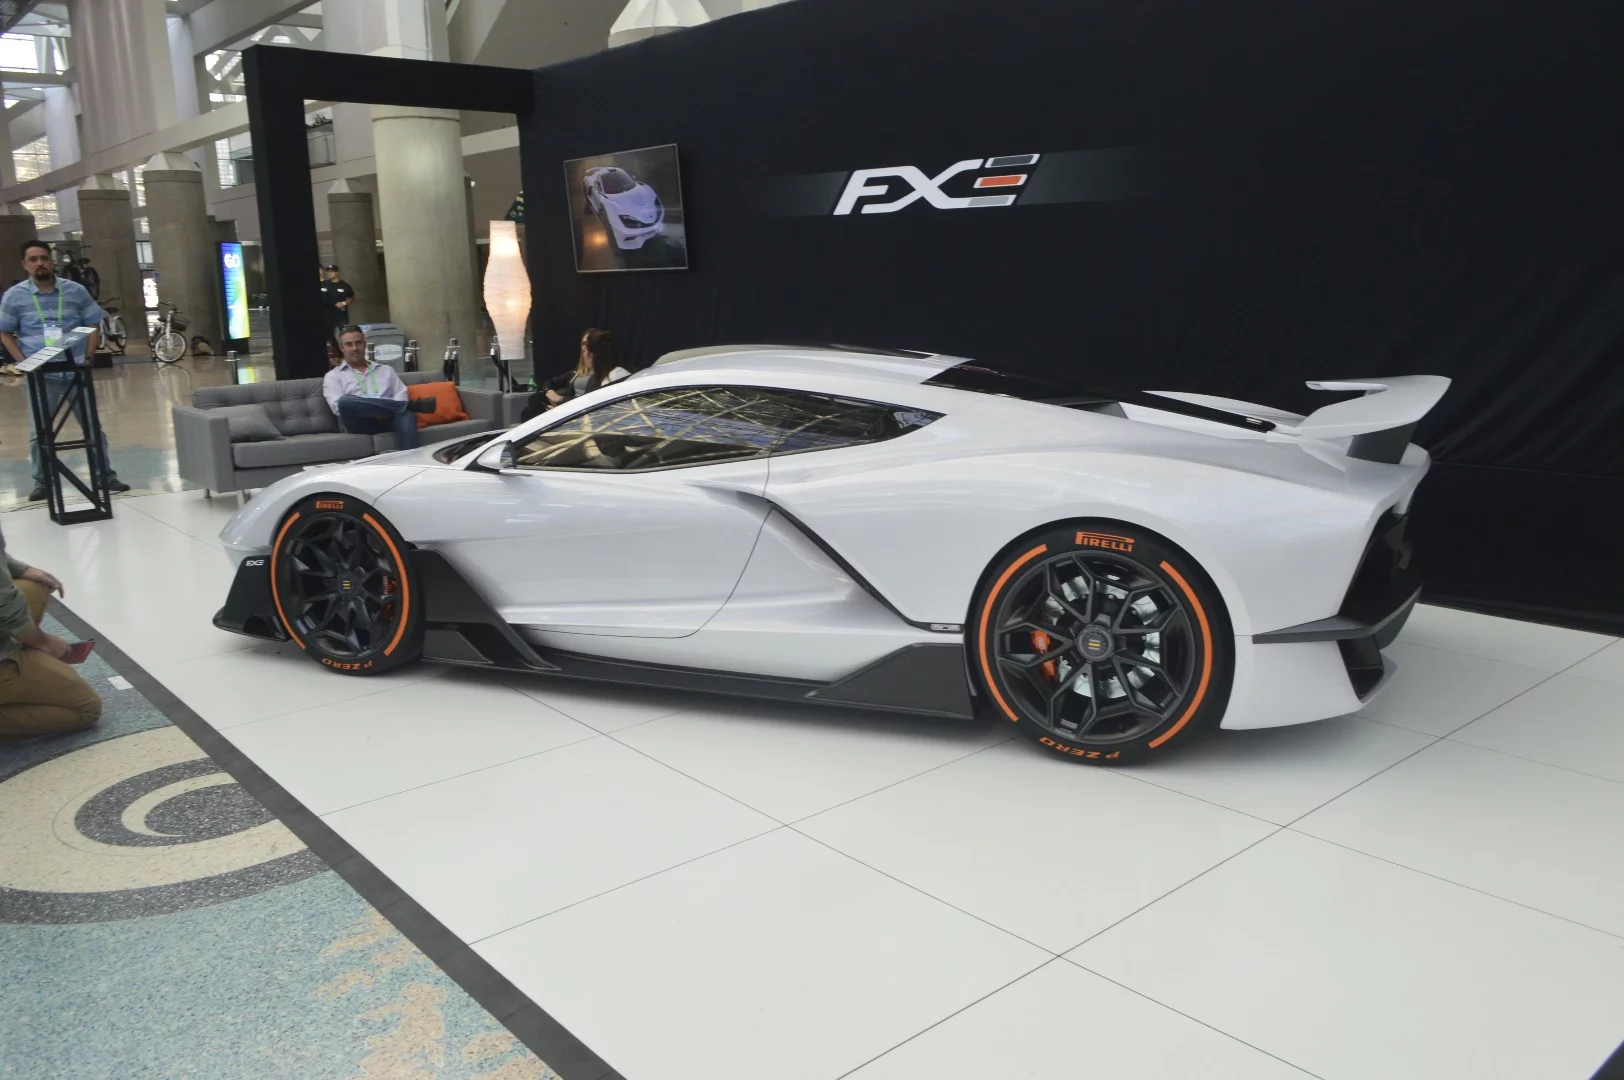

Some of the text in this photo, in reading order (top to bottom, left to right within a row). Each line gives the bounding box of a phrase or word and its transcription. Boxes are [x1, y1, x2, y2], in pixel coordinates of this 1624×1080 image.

[833, 153, 1040, 215] FXE
[315, 500, 345, 510] PIRELLI
[1075, 531, 1135, 552] PIRELLI
[321, 657, 373, 670] P ZERO
[1039, 736, 1121, 759] P ZERO
